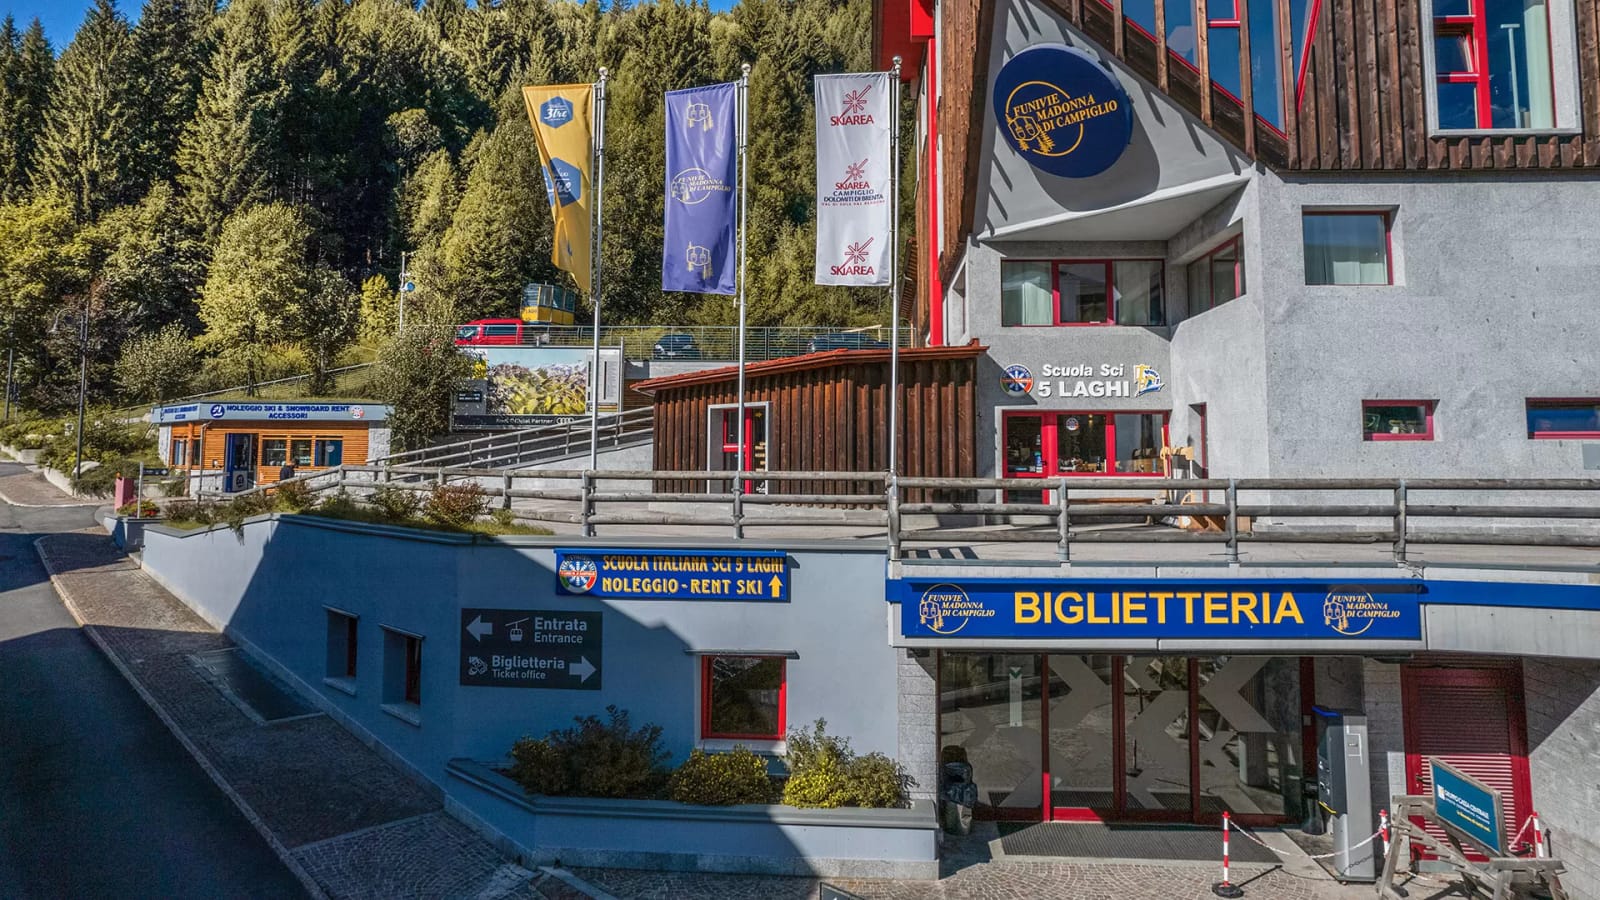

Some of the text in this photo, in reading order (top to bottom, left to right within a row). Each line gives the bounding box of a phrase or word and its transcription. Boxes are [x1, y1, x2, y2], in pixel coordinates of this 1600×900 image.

[1013, 93, 1060, 116] FUNIVIE
[1036, 94, 1096, 122] MADONNA
[1042, 100, 1118, 132] DI CAMPIGLIO
[833, 189, 874, 197] CAMPIGLIO
[1042, 363, 1125, 377] Scuola Sci
[1038, 380, 1131, 398] 5 LAGHI
[602, 555, 650, 572] SCUOLA
[653, 556, 709, 573] ITALIANA
[712, 557, 732, 573] SCI
[735, 557, 743, 573] 5
[747, 557, 784, 574] LAGHI
[602, 577, 679, 594] NOLEGGIO
[690, 579, 732, 595] RENT
[736, 579, 763, 595] SKI
[928, 594, 963, 602] FUNIVIE
[1332, 595, 1367, 603] FUNIVIE
[941, 609, 996, 617] DI CAMPIGLIO
[1014, 591, 1305, 624] BIGLIETTERIA
[1345, 602, 1388, 610] MADONNA
[1346, 610, 1401, 618] DI CAMPIGLIO
[534, 617, 588, 632] Entrata
[534, 631, 584, 644] Entrance
[491, 655, 566, 670] Biglietteria
[492, 669, 547, 680] Ticket office
